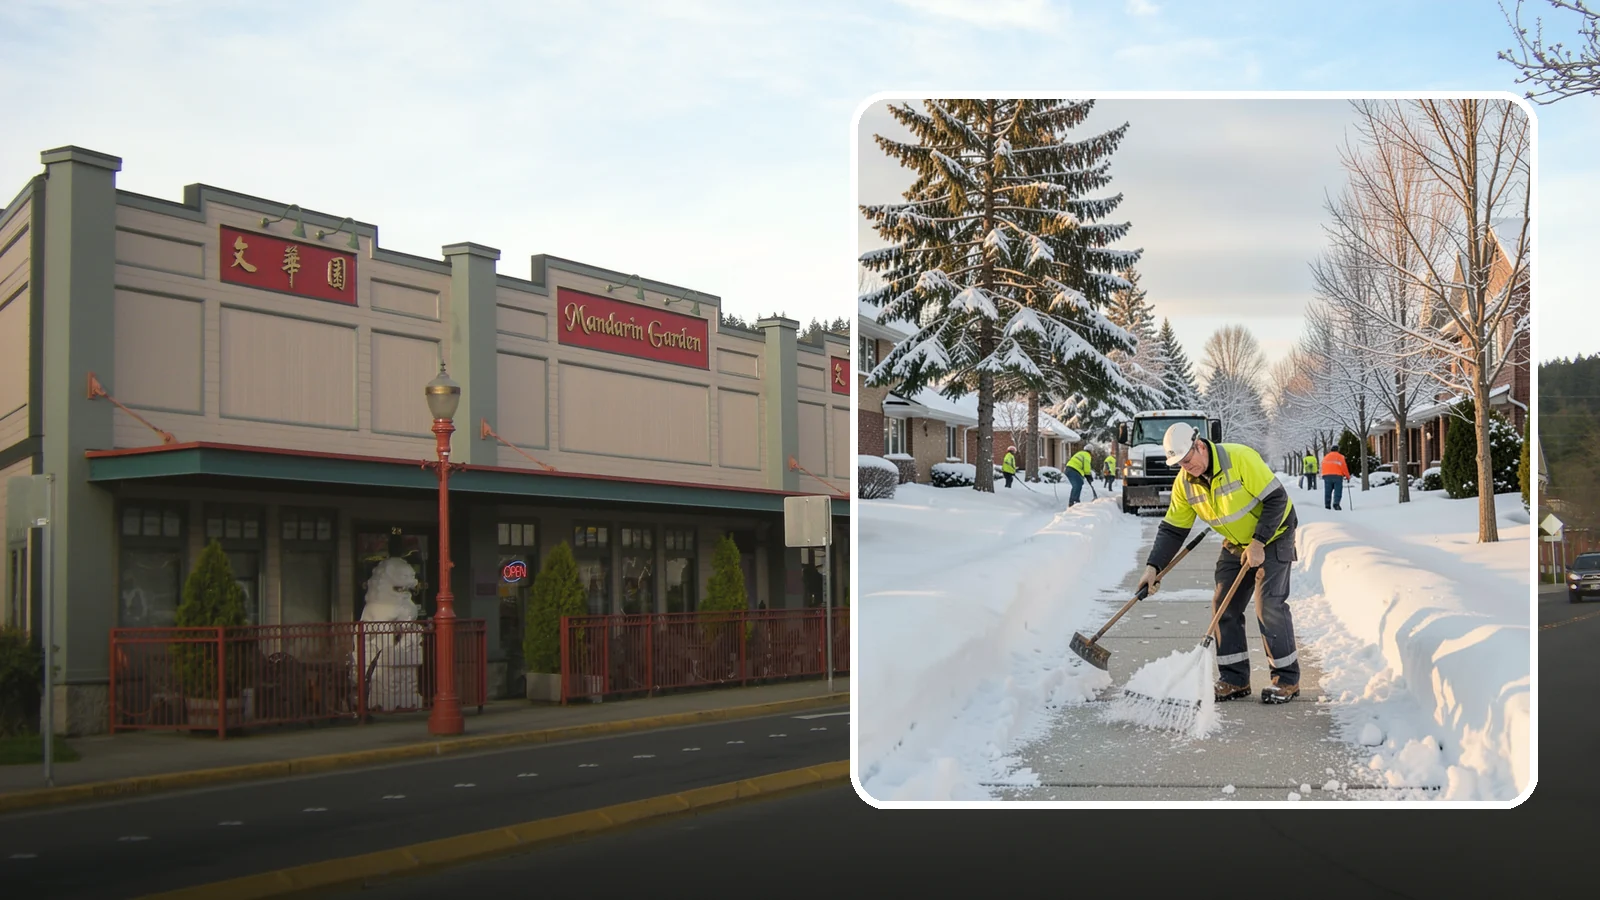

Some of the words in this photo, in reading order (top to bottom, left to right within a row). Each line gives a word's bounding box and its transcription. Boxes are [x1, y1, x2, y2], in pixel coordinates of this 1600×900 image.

[231, 235, 346, 291] 文華園
[564, 302, 644, 341] Mandarin
[648, 320, 702, 352] Garden
[503, 565, 527, 578] OPEN
